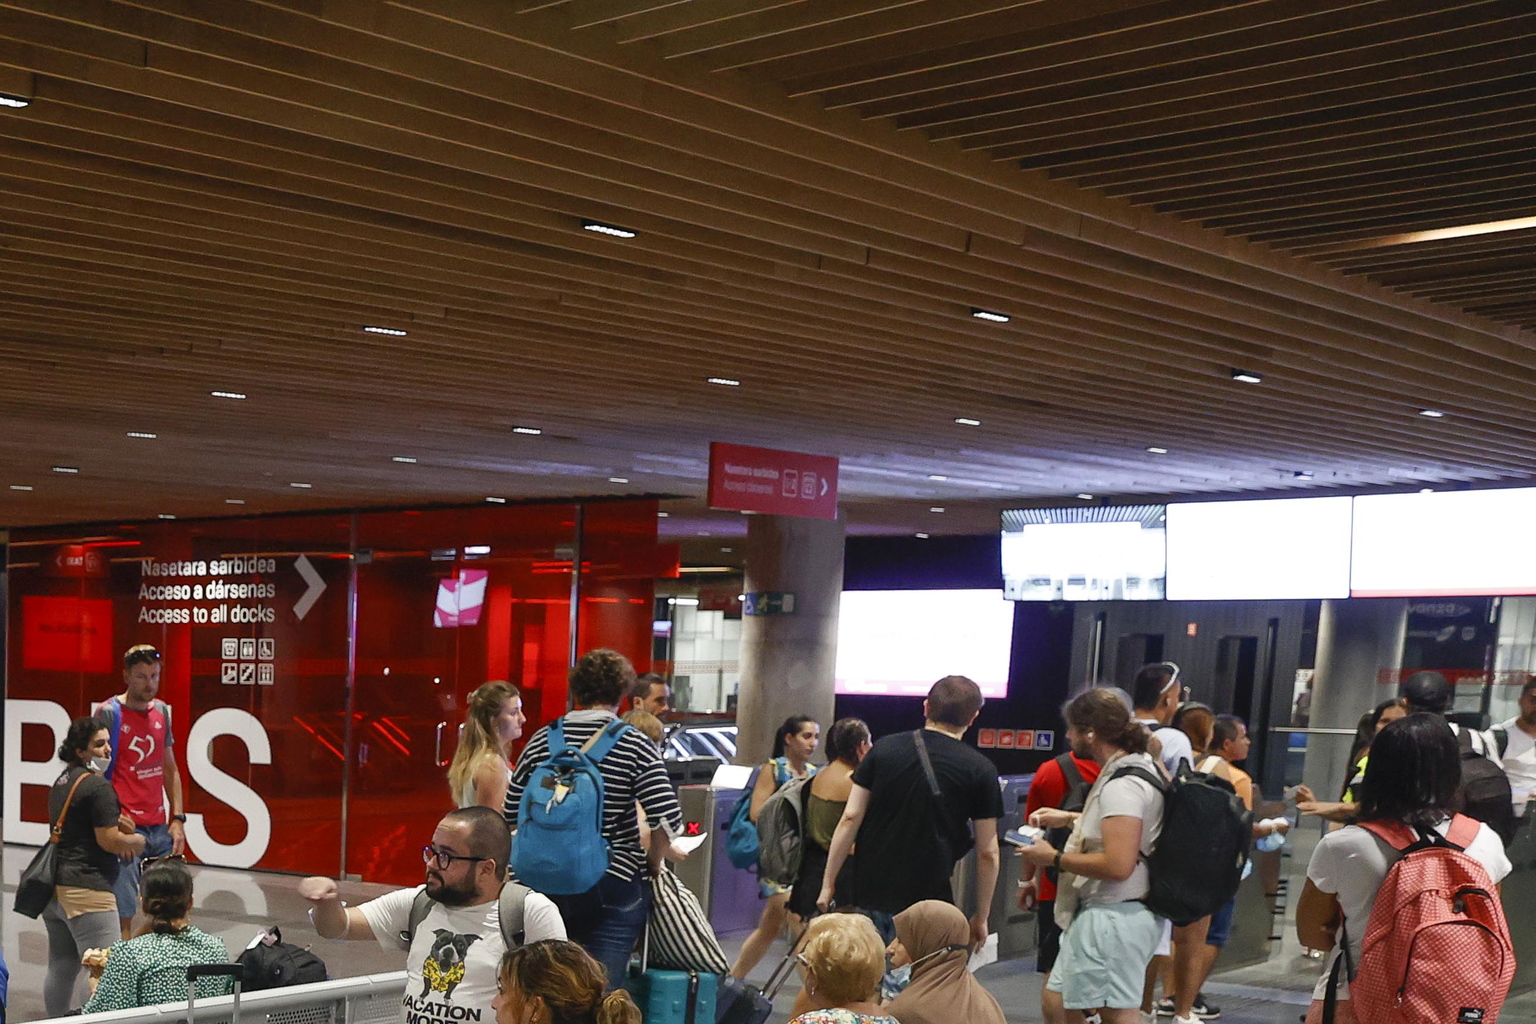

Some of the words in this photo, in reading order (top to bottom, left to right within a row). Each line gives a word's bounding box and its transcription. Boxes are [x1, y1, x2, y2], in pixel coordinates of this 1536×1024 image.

[141, 558, 207, 577] Nasetara
[209, 556, 276, 575] sarbidea
[138, 583, 191, 600] Acceso
[192, 585, 204, 600] a
[205, 579, 276, 599] dársenas
[138, 606, 190, 624] Access
[192, 606, 208, 623] to
[210, 604, 227, 623] all
[230, 604, 276, 623] docks
[2, 698, 272, 869] BS
